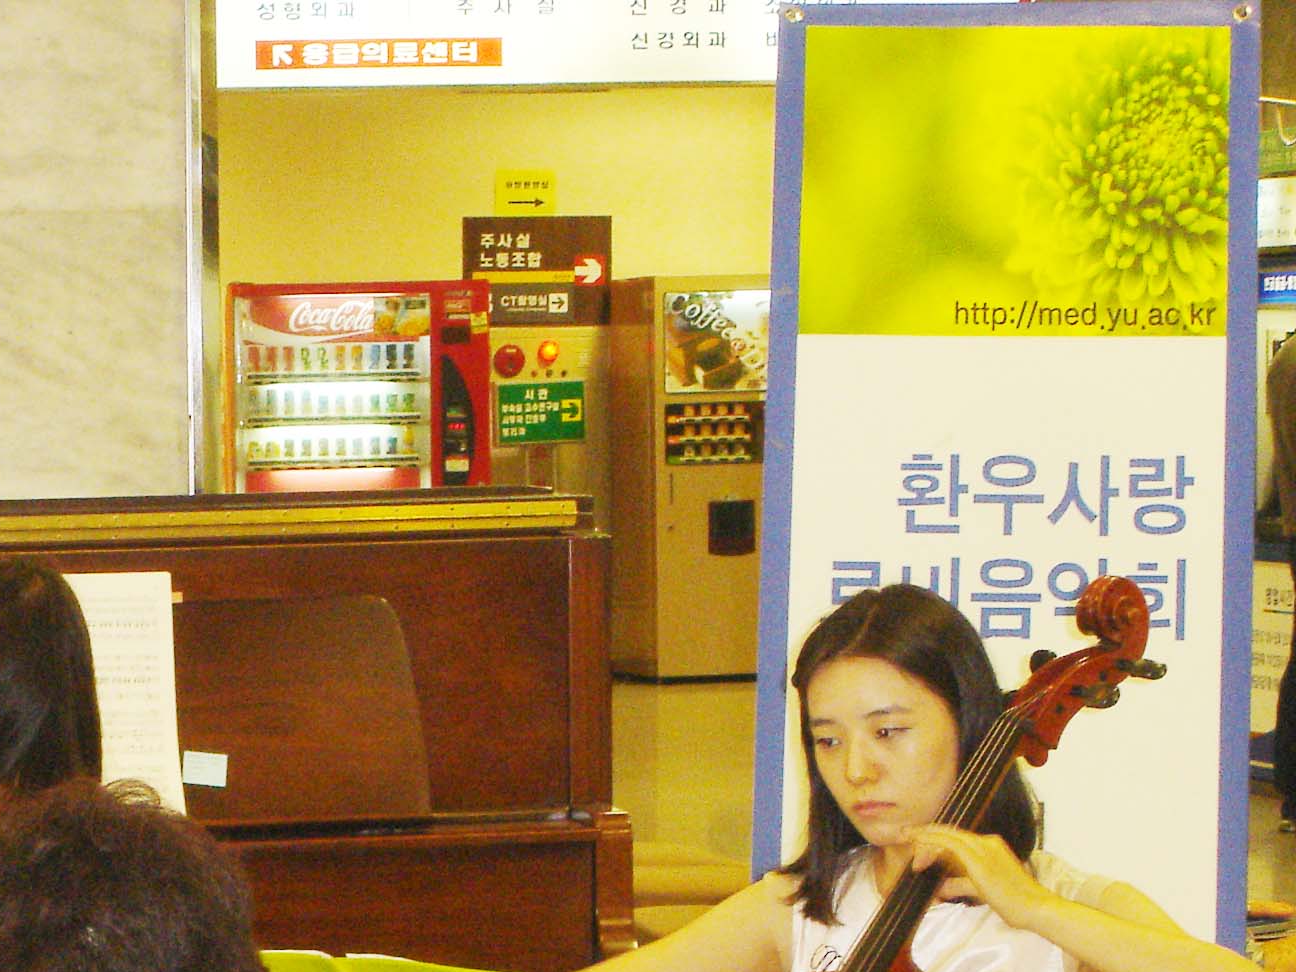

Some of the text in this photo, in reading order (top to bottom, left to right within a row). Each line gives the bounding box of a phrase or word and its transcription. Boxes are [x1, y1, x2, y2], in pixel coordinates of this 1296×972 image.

[302, 41, 478, 65] 응급의료센터
[480, 233, 530, 249] 주사실
[480, 252, 542, 268] 노동조합
[954, 300, 1216, 333] http://med.yu.ac.kr
[897, 453, 1195, 537] 환우사랑
